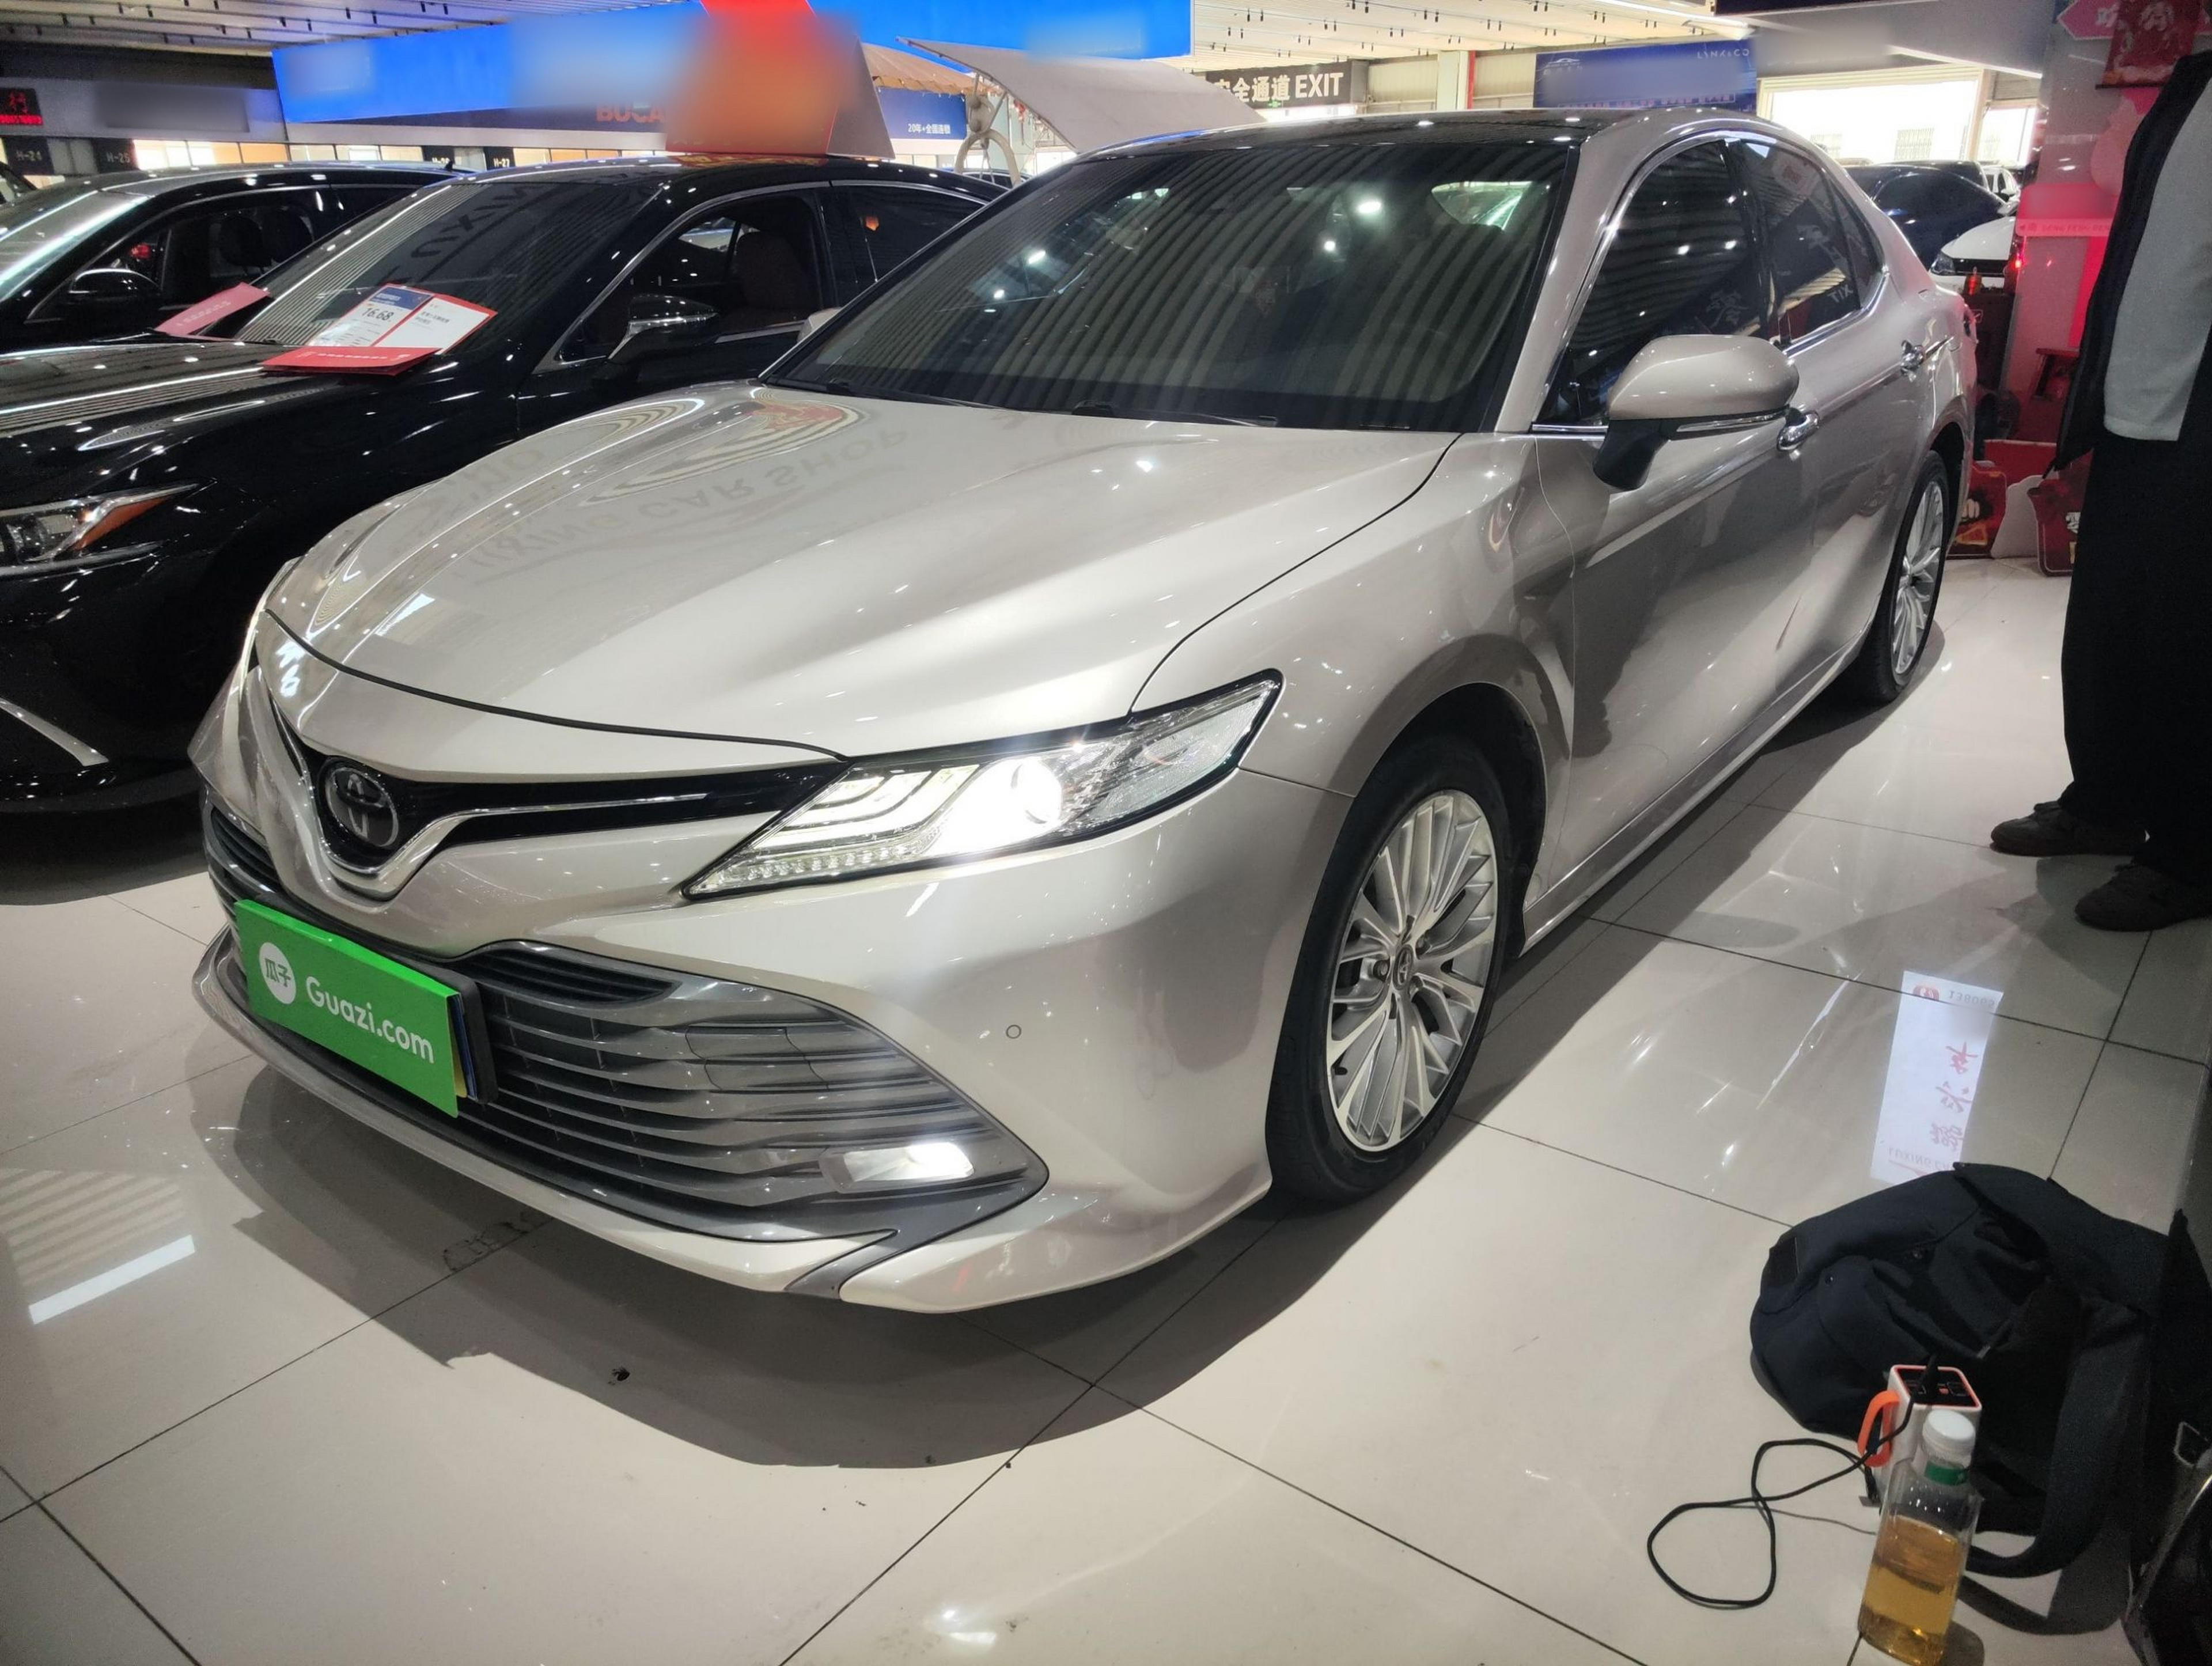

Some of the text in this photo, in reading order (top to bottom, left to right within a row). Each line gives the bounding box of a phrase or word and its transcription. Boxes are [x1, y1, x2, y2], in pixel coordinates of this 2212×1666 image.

[1295, 72, 1344, 98] EXIT
[16, 150, 42, 161] H-24
[106, 151, 130, 163] H-25
[493, 157, 510, 168] H-27
[362, 307, 395, 321] 16.68
[264, 958, 291, 987] 瓜子
[306, 976, 435, 1064] Guazi.com
